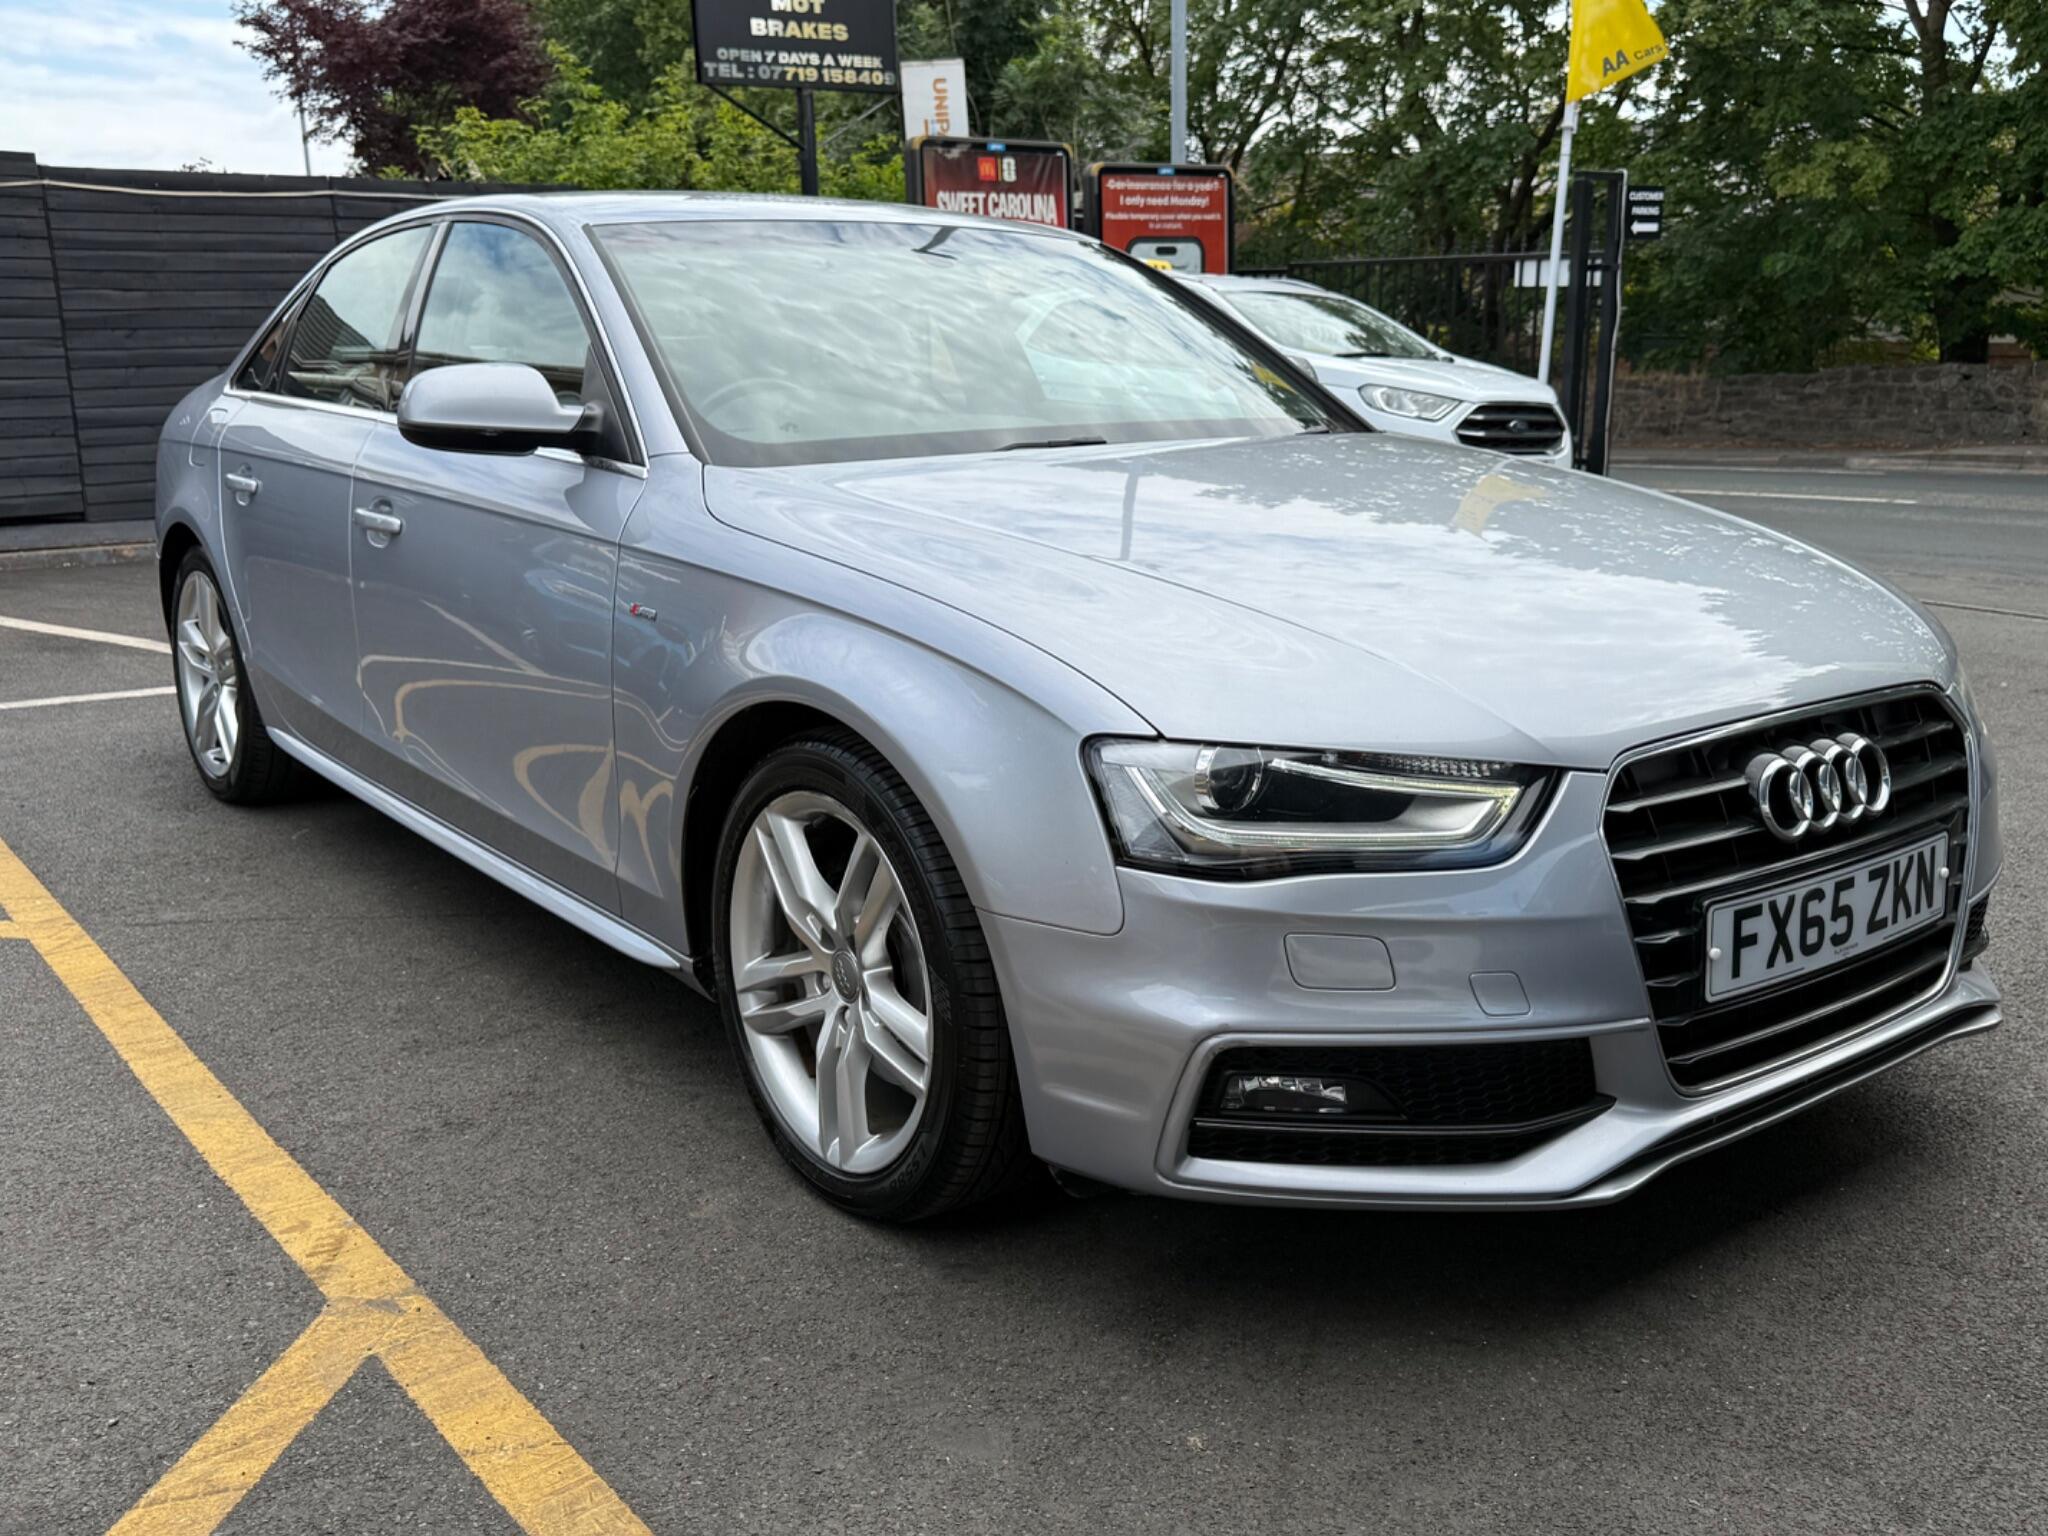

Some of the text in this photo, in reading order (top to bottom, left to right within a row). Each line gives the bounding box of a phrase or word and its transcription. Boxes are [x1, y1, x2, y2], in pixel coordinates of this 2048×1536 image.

[771, 0, 825, 14] MOT
[750, 17, 849, 41] BRAKES
[716, 47, 884, 69] OPEN 7 DAYS A WEEK
[1603, 49, 1630, 77] AA
[936, 190, 1058, 226] SWEET CAROLINA
[1731, 846, 1936, 979] FX65 ZKN
